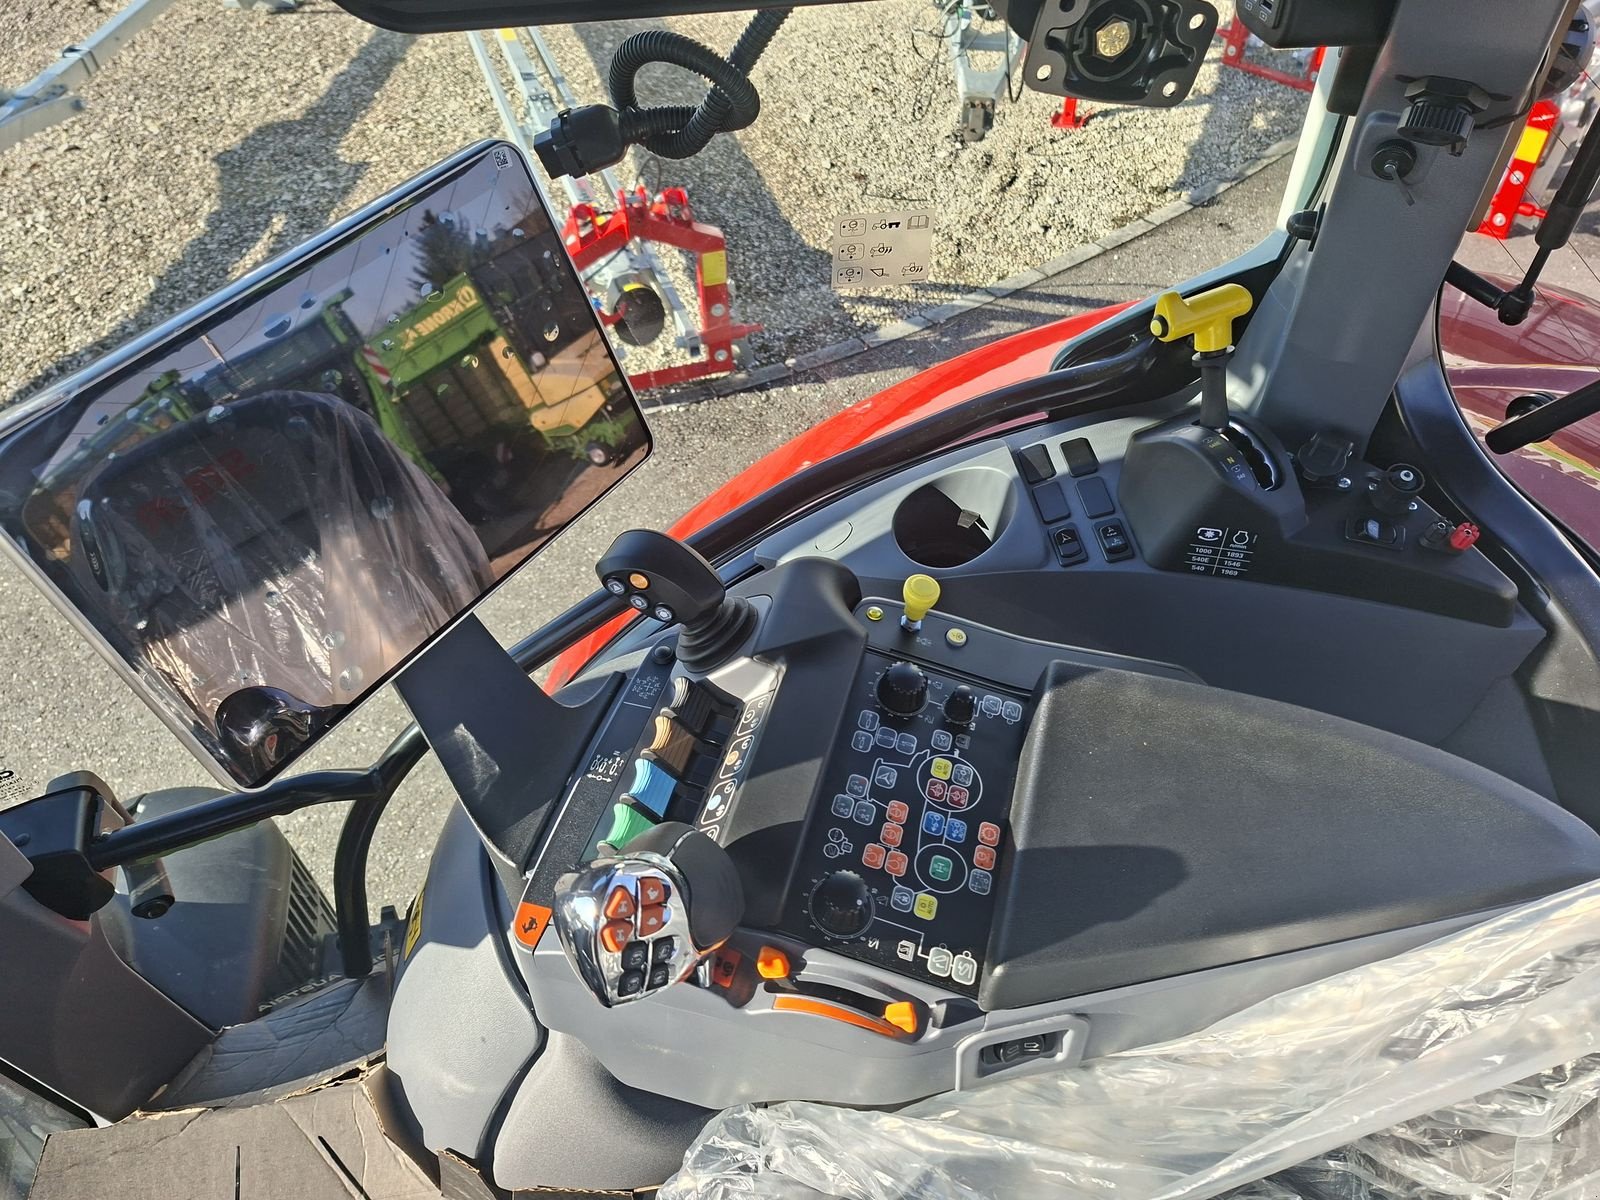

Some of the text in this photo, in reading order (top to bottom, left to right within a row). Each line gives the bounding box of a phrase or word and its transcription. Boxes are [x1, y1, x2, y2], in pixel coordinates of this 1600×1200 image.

[1226, 456, 1236, 464] N
[1226, 551, 1244, 559] 1893
[1191, 555, 1241, 568] 540E 1546
[927, 900, 935, 915] AUTO
